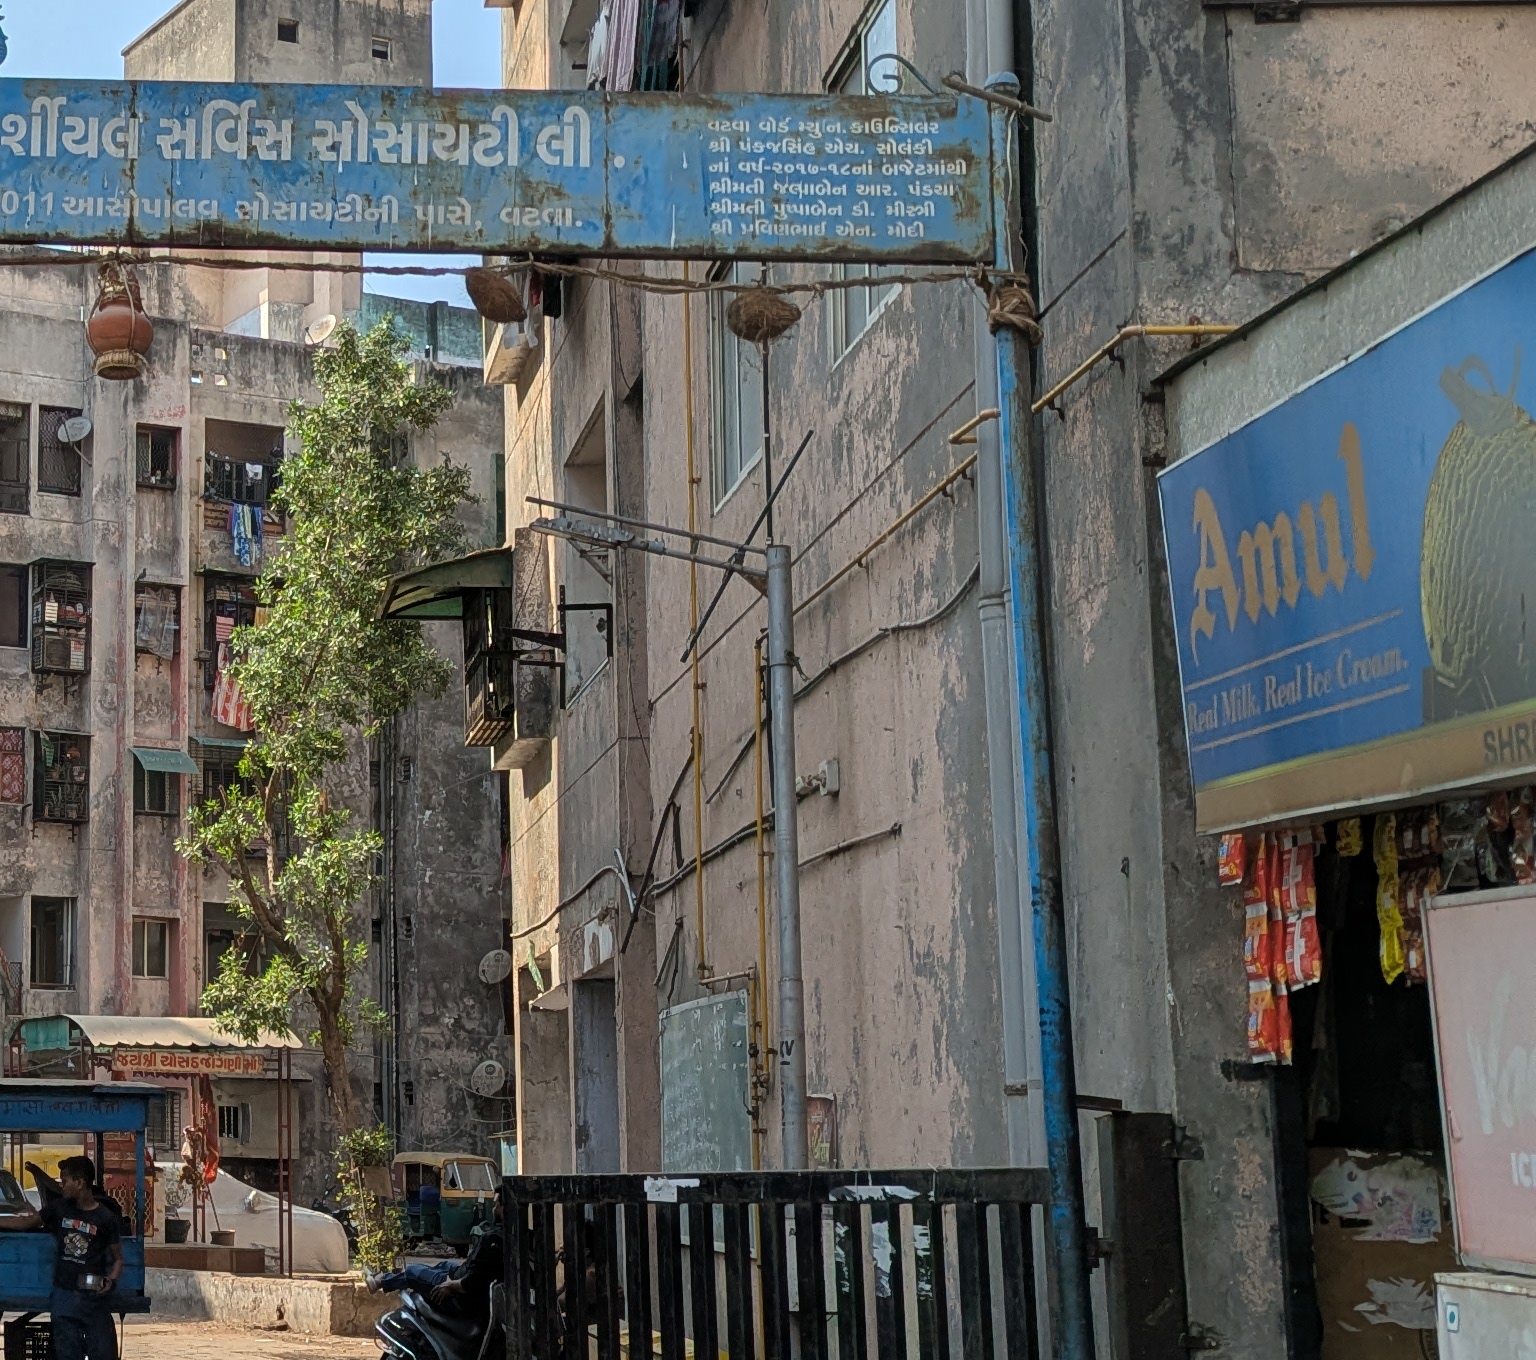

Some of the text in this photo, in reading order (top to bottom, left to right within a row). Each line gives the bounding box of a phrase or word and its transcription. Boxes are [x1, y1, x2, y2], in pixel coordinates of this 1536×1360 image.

[157, 100, 294, 161] સર્વિસ
[312, 101, 518, 167] સોસાયટી
[707, 120, 750, 133] વટવા
[758, 117, 792, 133] વોર્ડ
[708, 137, 730, 153] શ્રી
[824, 138, 864, 155] એચ.
[876, 138, 932, 155] સોલંકી
[710, 177, 764, 195] શ્રીમતી
[855, 183, 898, 197] આર.
[235, 192, 398, 224] સોસાયટીની
[710, 198, 765, 215] શ્રીમતી
[851, 200, 875, 217] ડી.
[711, 218, 732, 235] શ્રી
[835, 220, 876, 237] એન.
[887, 221, 925, 238] મોદી
[1190, 421, 1376, 667] Amul
[1187, 700, 1217, 733] Real
[1264, 663, 1302, 712] Real
[1306, 661, 1332, 699] Ice
